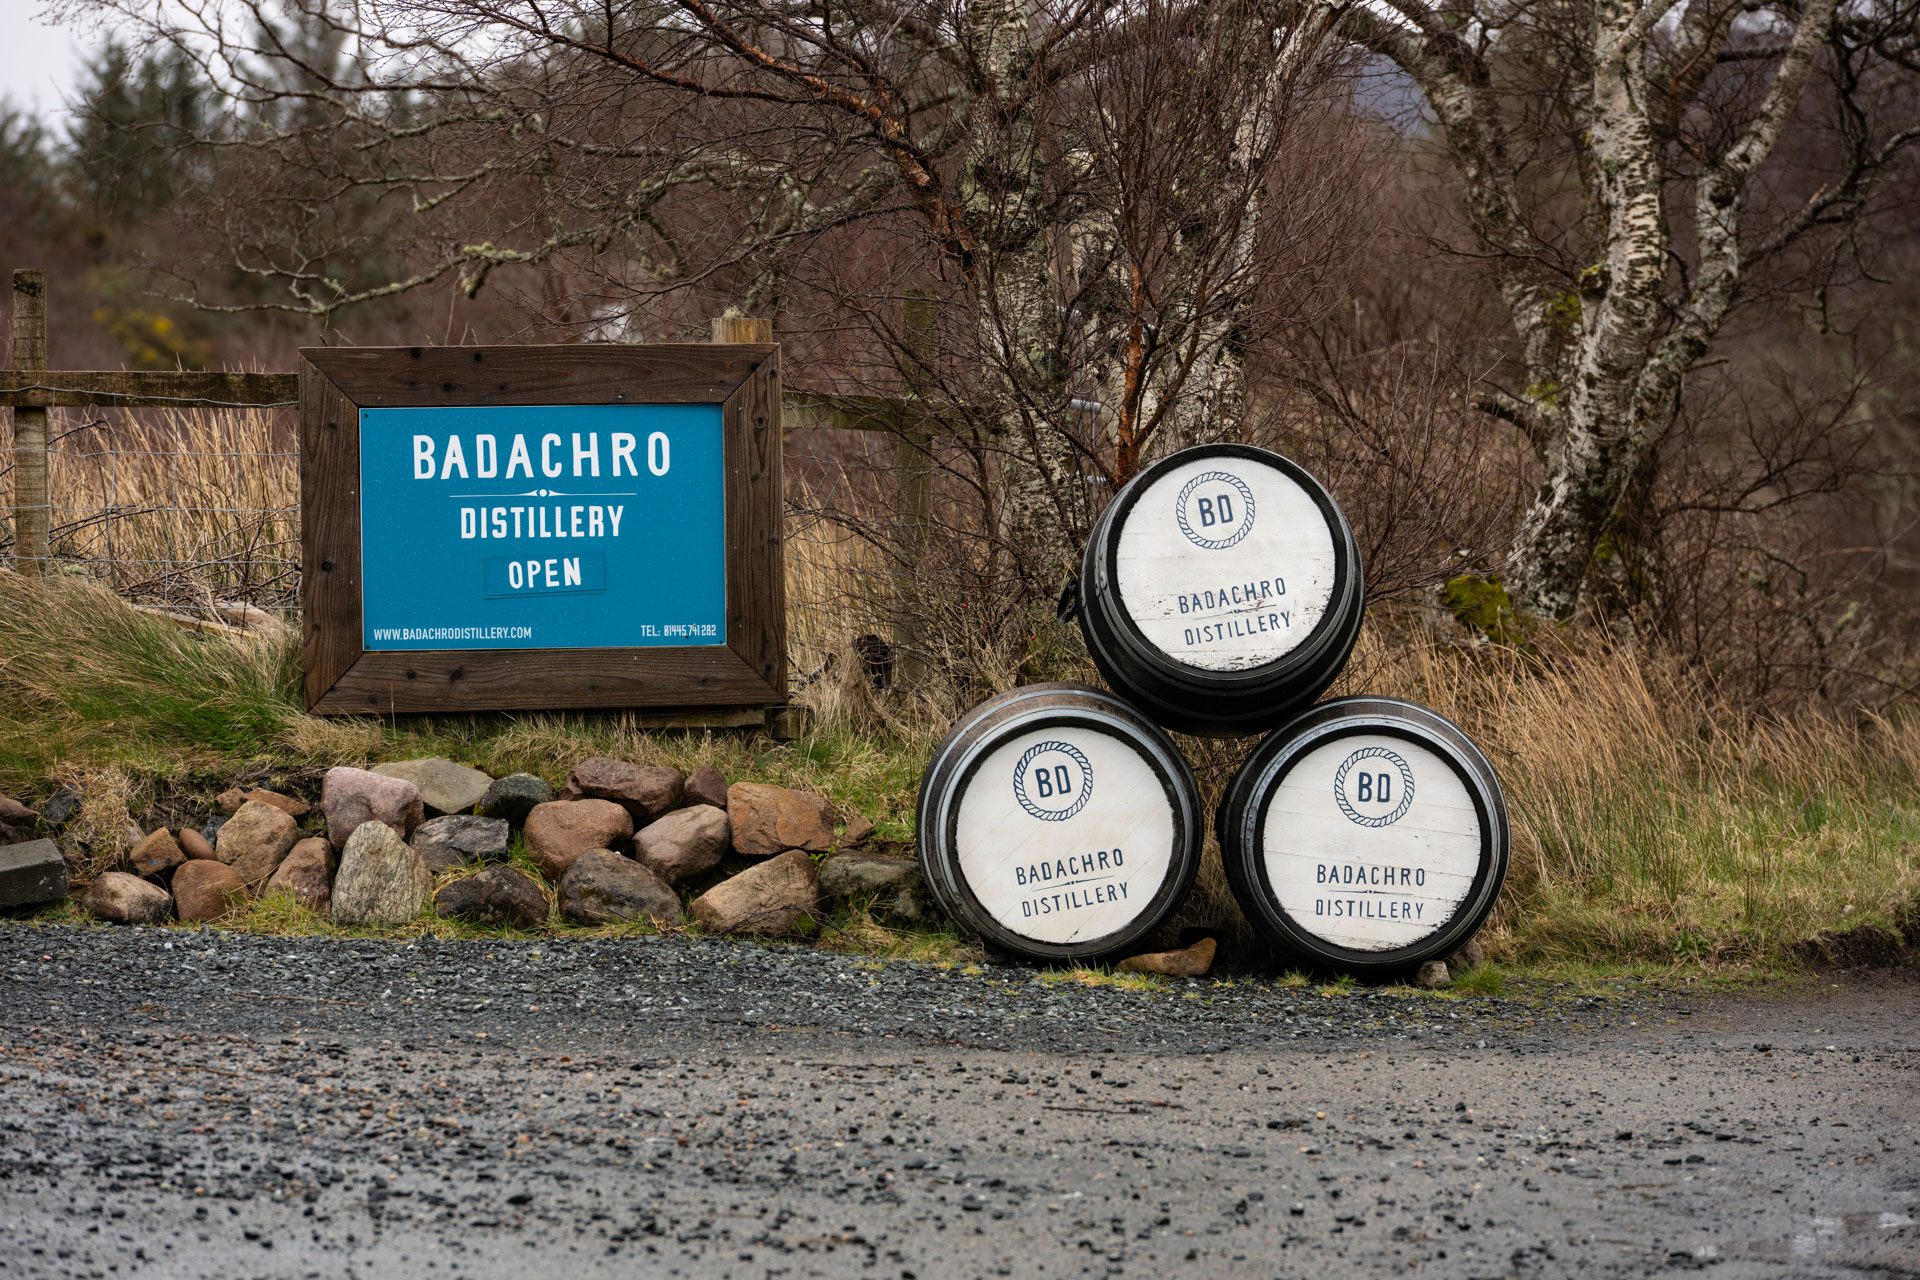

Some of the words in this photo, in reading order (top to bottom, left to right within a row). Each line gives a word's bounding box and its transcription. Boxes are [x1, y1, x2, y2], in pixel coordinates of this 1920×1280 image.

[412, 431, 671, 480] BADACHRO
[460, 505, 624, 539] DISTILLERY
[1198, 494, 1234, 528] BD
[508, 557, 582, 590] OPEN
[1178, 577, 1287, 614] BADACHRO
[373, 626, 532, 641] WWW.BADACHRODISTILLERY.COM
[640, 624, 661, 637] TEL:
[1184, 610, 1290, 646] DISTILLERY
[1034, 764, 1072, 798] BD
[1357, 771, 1391, 803] BD
[1015, 848, 1124, 886] BADACHRO
[1316, 863, 1426, 887] BADACHRO
[1021, 881, 1129, 918] DISTILLERY
[1315, 899, 1424, 920] DISTILLERY
